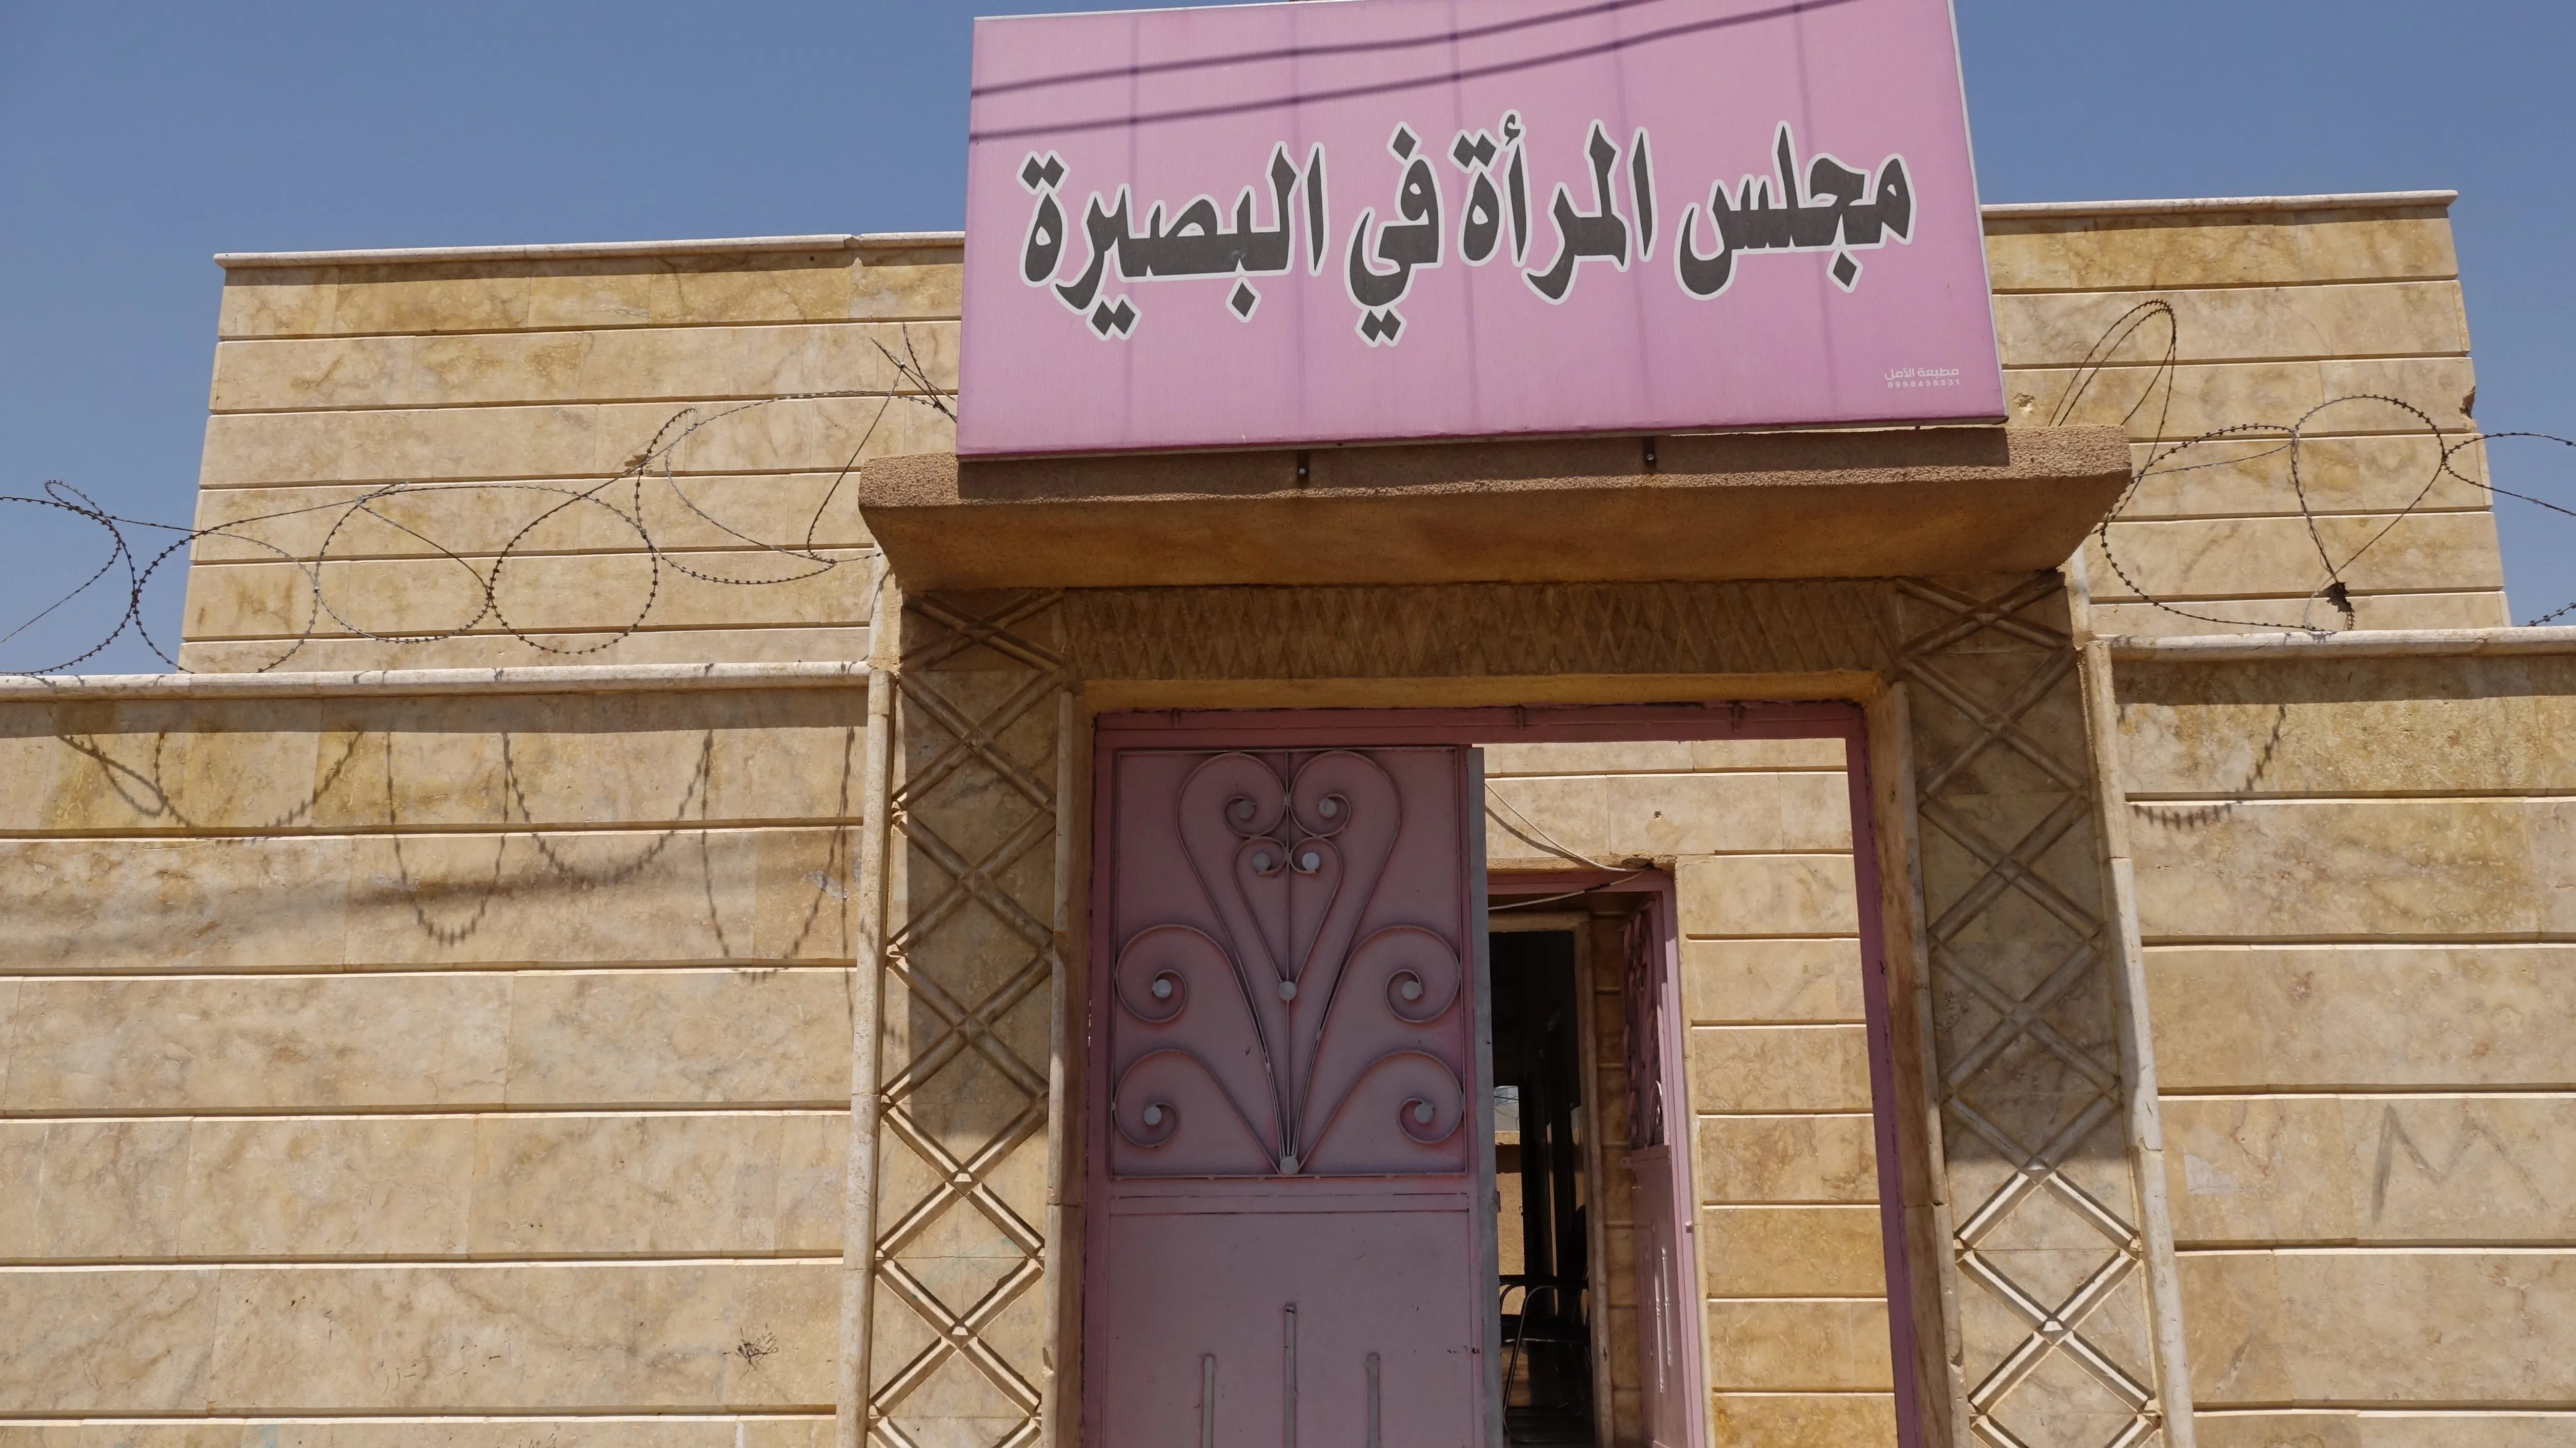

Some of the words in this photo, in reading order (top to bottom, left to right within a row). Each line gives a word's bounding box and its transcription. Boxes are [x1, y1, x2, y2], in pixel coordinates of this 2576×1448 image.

[1019, 144, 1325, 338] البصيرة
[1347, 125, 1441, 344] في
[1451, 113, 1655, 302] المرأة
[1677, 123, 1913, 298] مجلس
[1884, 367, 1915, 380] الأمل
[1917, 367, 1959, 378] مطبعة
